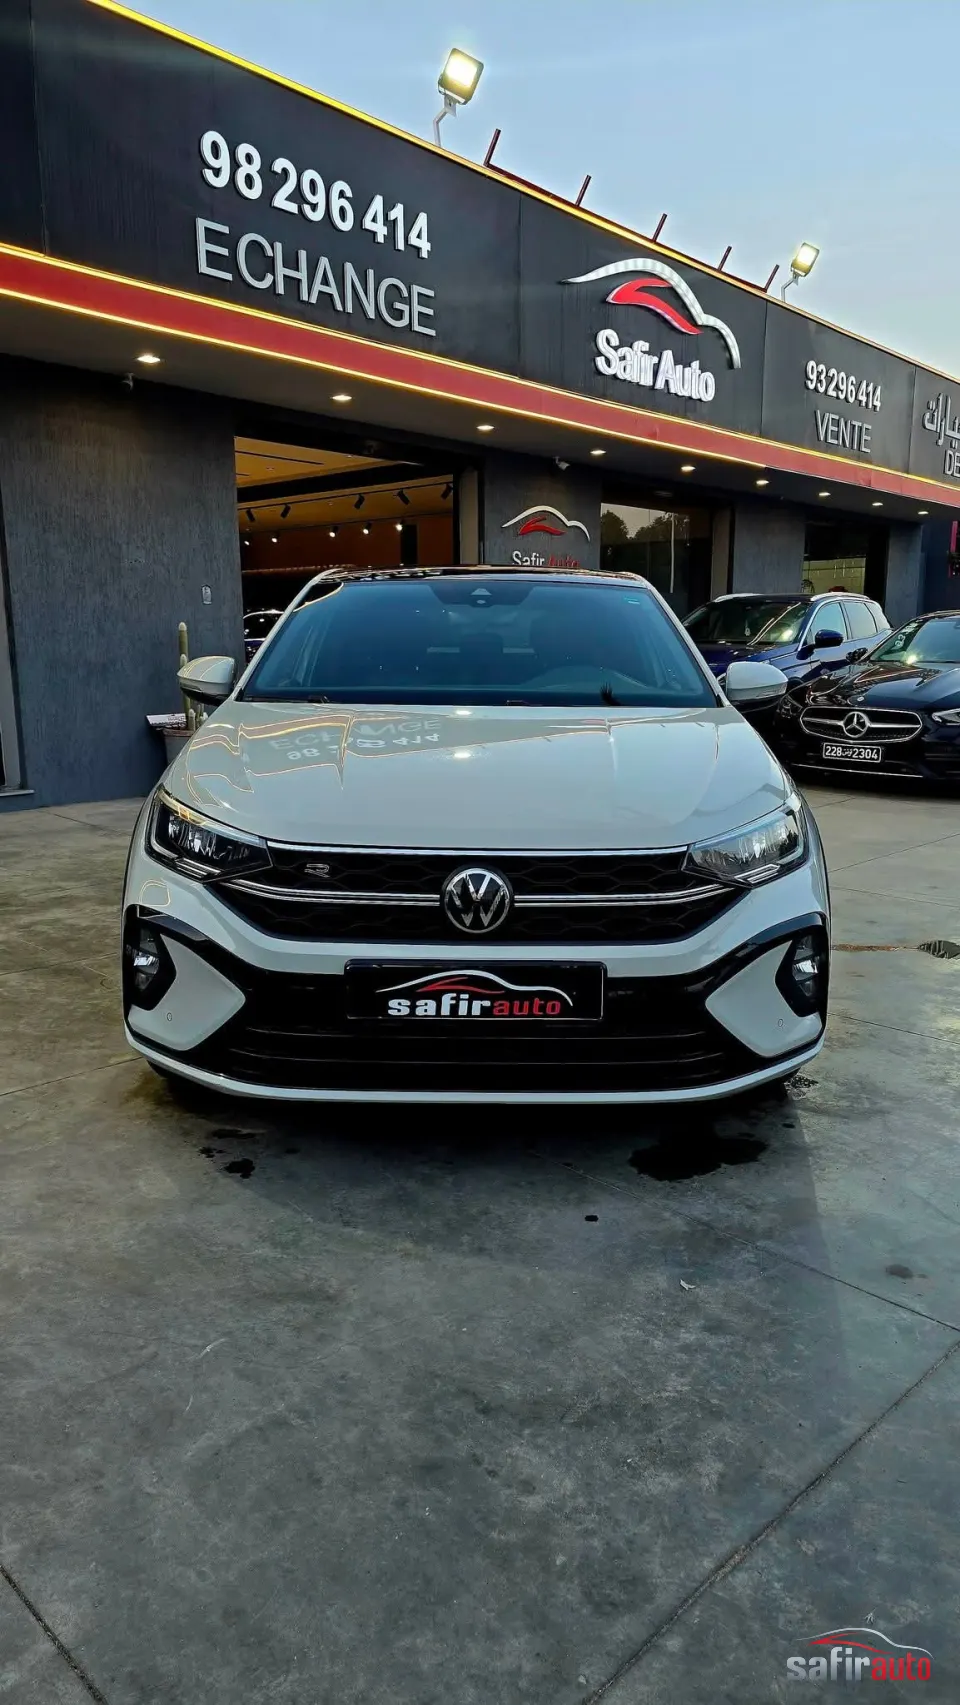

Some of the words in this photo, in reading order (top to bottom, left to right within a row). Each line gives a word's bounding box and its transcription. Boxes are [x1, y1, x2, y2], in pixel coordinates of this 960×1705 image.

[200, 130, 263, 200] 98
[270, 157, 354, 232] 296
[361, 194, 432, 259] 414
[195, 217, 437, 337] ECHANGE
[595, 328, 659, 386] Safir
[654, 349, 716, 402] Auto
[815, 409, 872, 454] VENTE
[512, 550, 546, 566] Safir
